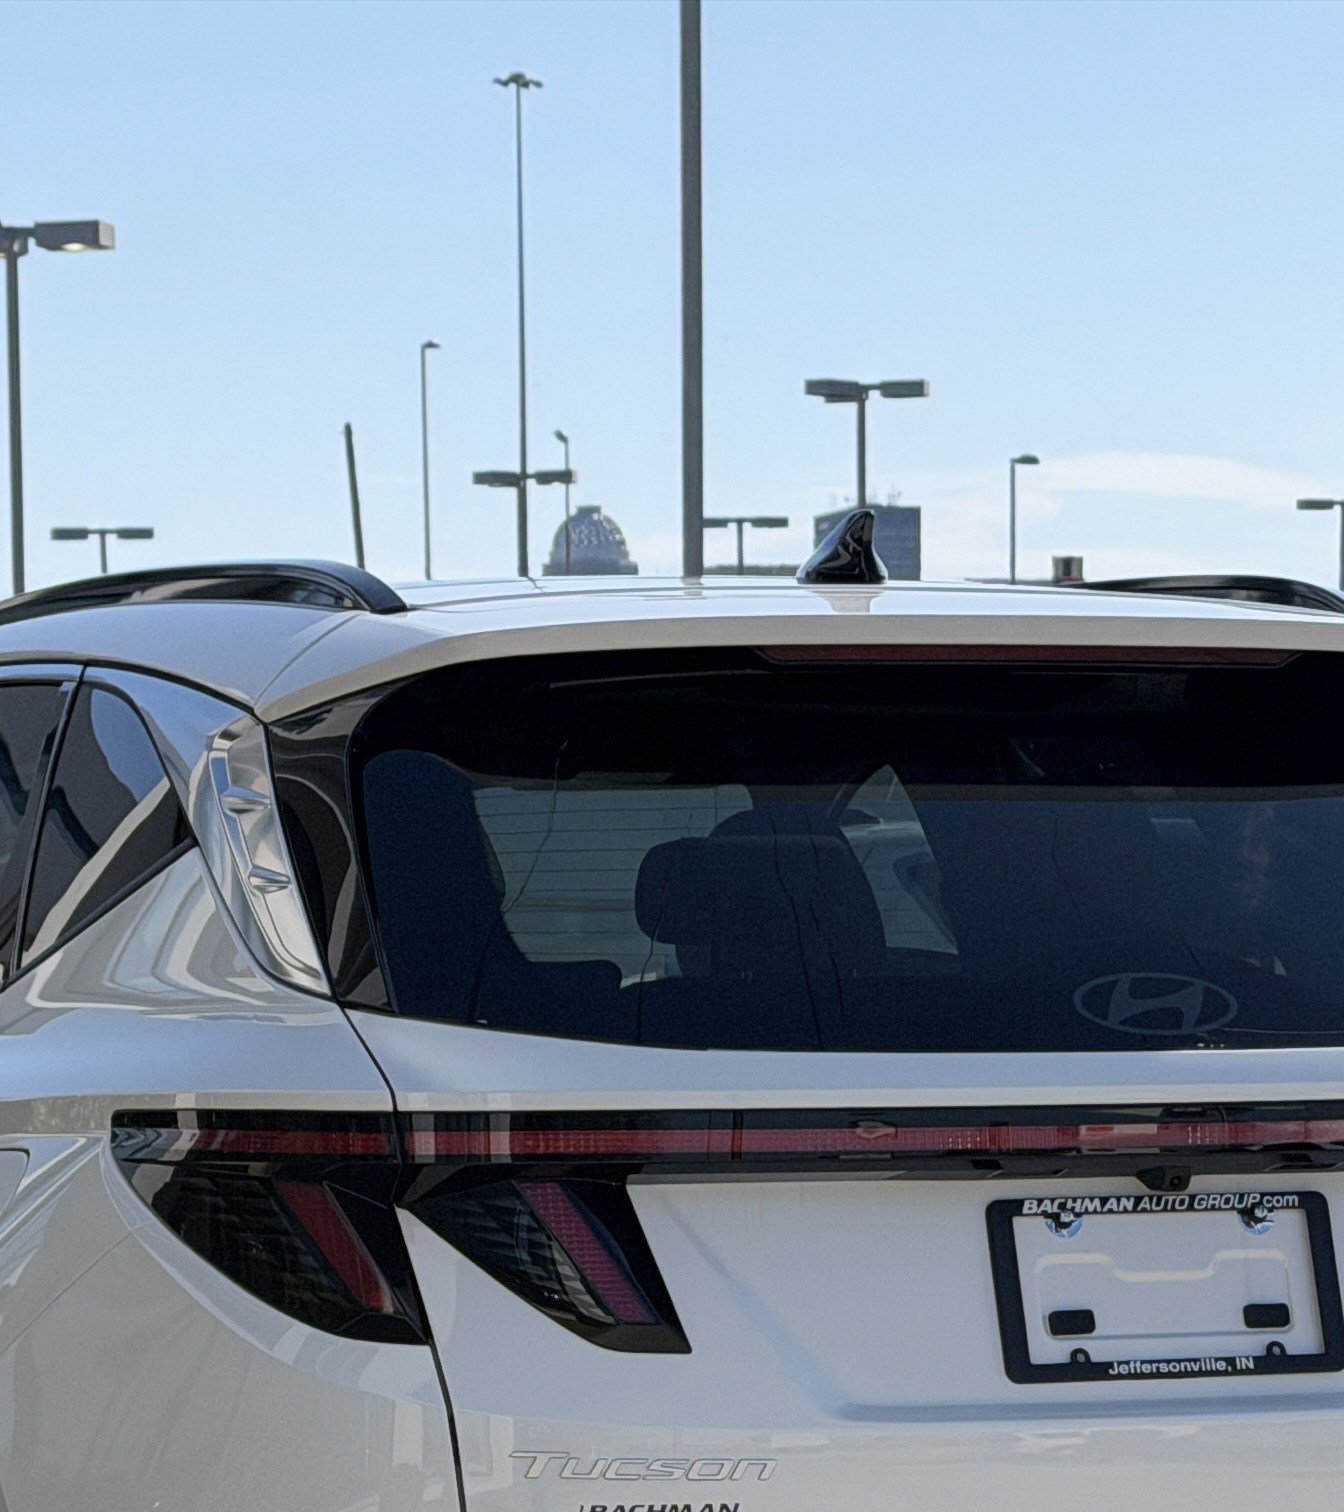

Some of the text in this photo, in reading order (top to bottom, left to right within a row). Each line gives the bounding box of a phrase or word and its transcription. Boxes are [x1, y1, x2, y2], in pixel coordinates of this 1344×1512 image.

[1022, 1197, 1135, 1215] BACHMAN
[1137, 1195, 1189, 1211] AUTO
[1108, 1356, 1255, 1375] Jeffersonville, IN
